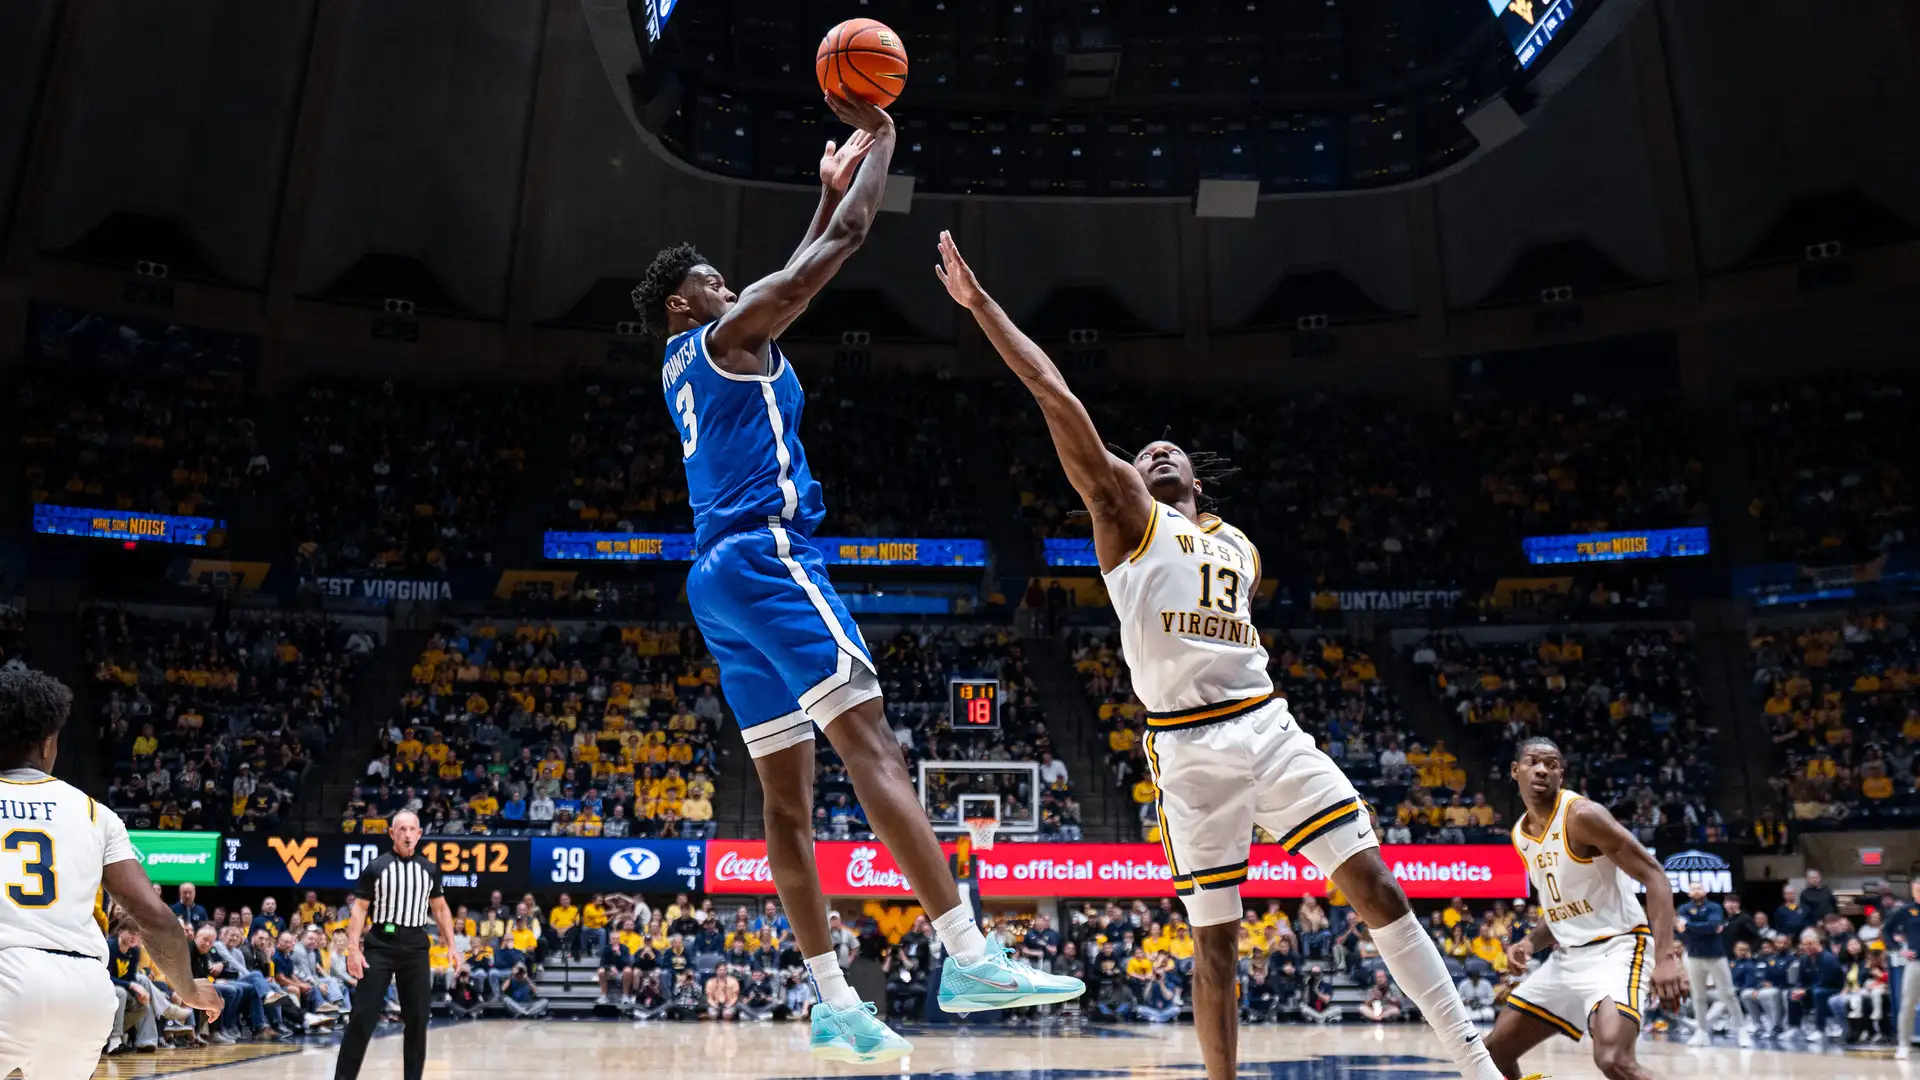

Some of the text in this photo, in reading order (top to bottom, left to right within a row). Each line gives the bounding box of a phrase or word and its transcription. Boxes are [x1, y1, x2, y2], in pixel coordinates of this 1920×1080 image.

[676, 380, 698, 459] 3
[130, 517, 166, 536] NOISE
[629, 538, 663, 554] NOISE
[878, 543, 919, 561] NOISE
[1176, 534, 1248, 570] WEST
[1612, 537, 1648, 554] NOISE
[363, 578, 453, 601] VIRGINIA
[1198, 562, 1240, 615] 13
[968, 698, 991, 724] 18
[229, 847, 237, 861] 2
[422, 842, 509, 873] 13:12
[551, 847, 585, 883] 39
[1, 828, 59, 909] 3
[223, 862, 249, 871] FOULS
[977, 859, 1008, 880] he
[1012, 859, 1093, 880] official
[1098, 859, 1172, 880] chicke
[1247, 860, 1297, 881] wich
[1392, 861, 1492, 881] Athletics
[225, 871, 235, 885] 4
[471, 873, 478, 888] 2
[686, 876, 696, 891] 4
[1546, 872, 1561, 903] 0
[1548, 899, 1594, 922] RGINIA
